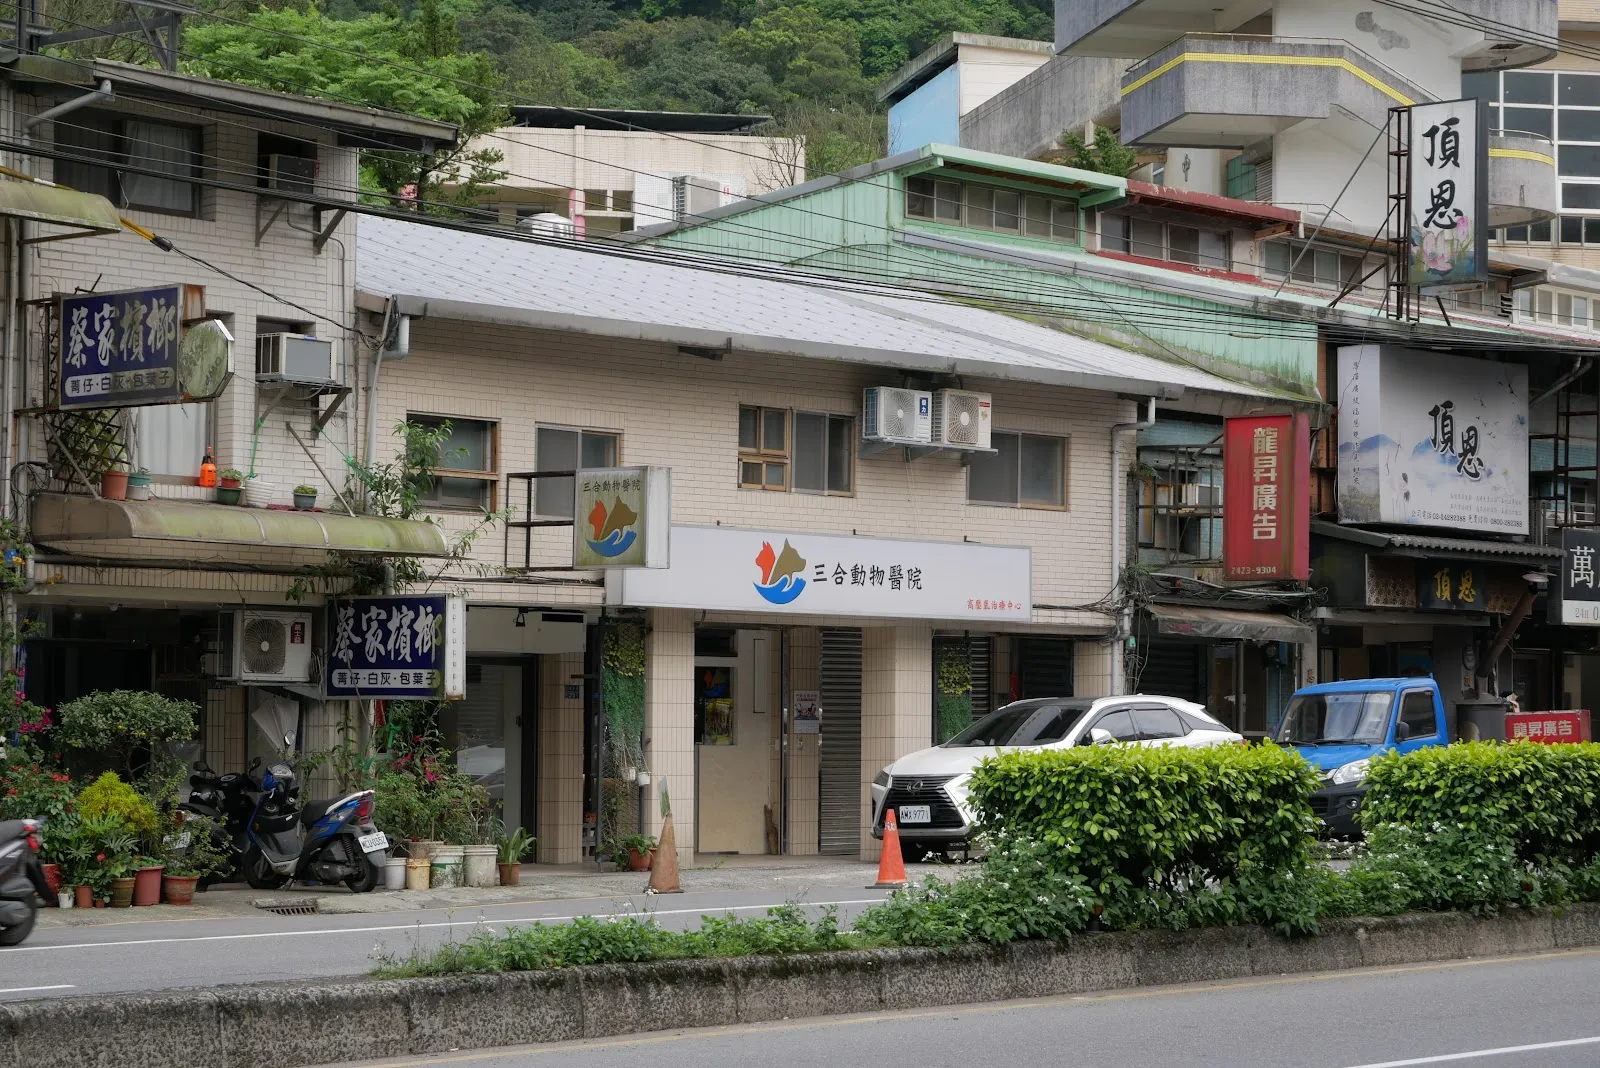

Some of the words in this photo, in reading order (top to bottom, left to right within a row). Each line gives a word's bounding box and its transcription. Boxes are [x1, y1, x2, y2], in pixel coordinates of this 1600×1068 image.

[1422, 117, 1463, 229] 頂恩
[65, 297, 176, 368] 蔡家檳榔
[1428, 400, 1483, 478] 頂恩
[583, 479, 641, 492] 三合動物醫院
[1252, 427, 1278, 540] 龍昇廣告
[812, 562, 922, 590] 三合動物醫院
[1231, 566, 1277, 575] 2423-9304
[1434, 568, 1477, 603] 頂恩
[1569, 546, 1600, 588] 萬
[332, 605, 442, 663] 蔡家檳榔
[1513, 720, 1572, 737] 龍昇廣告
